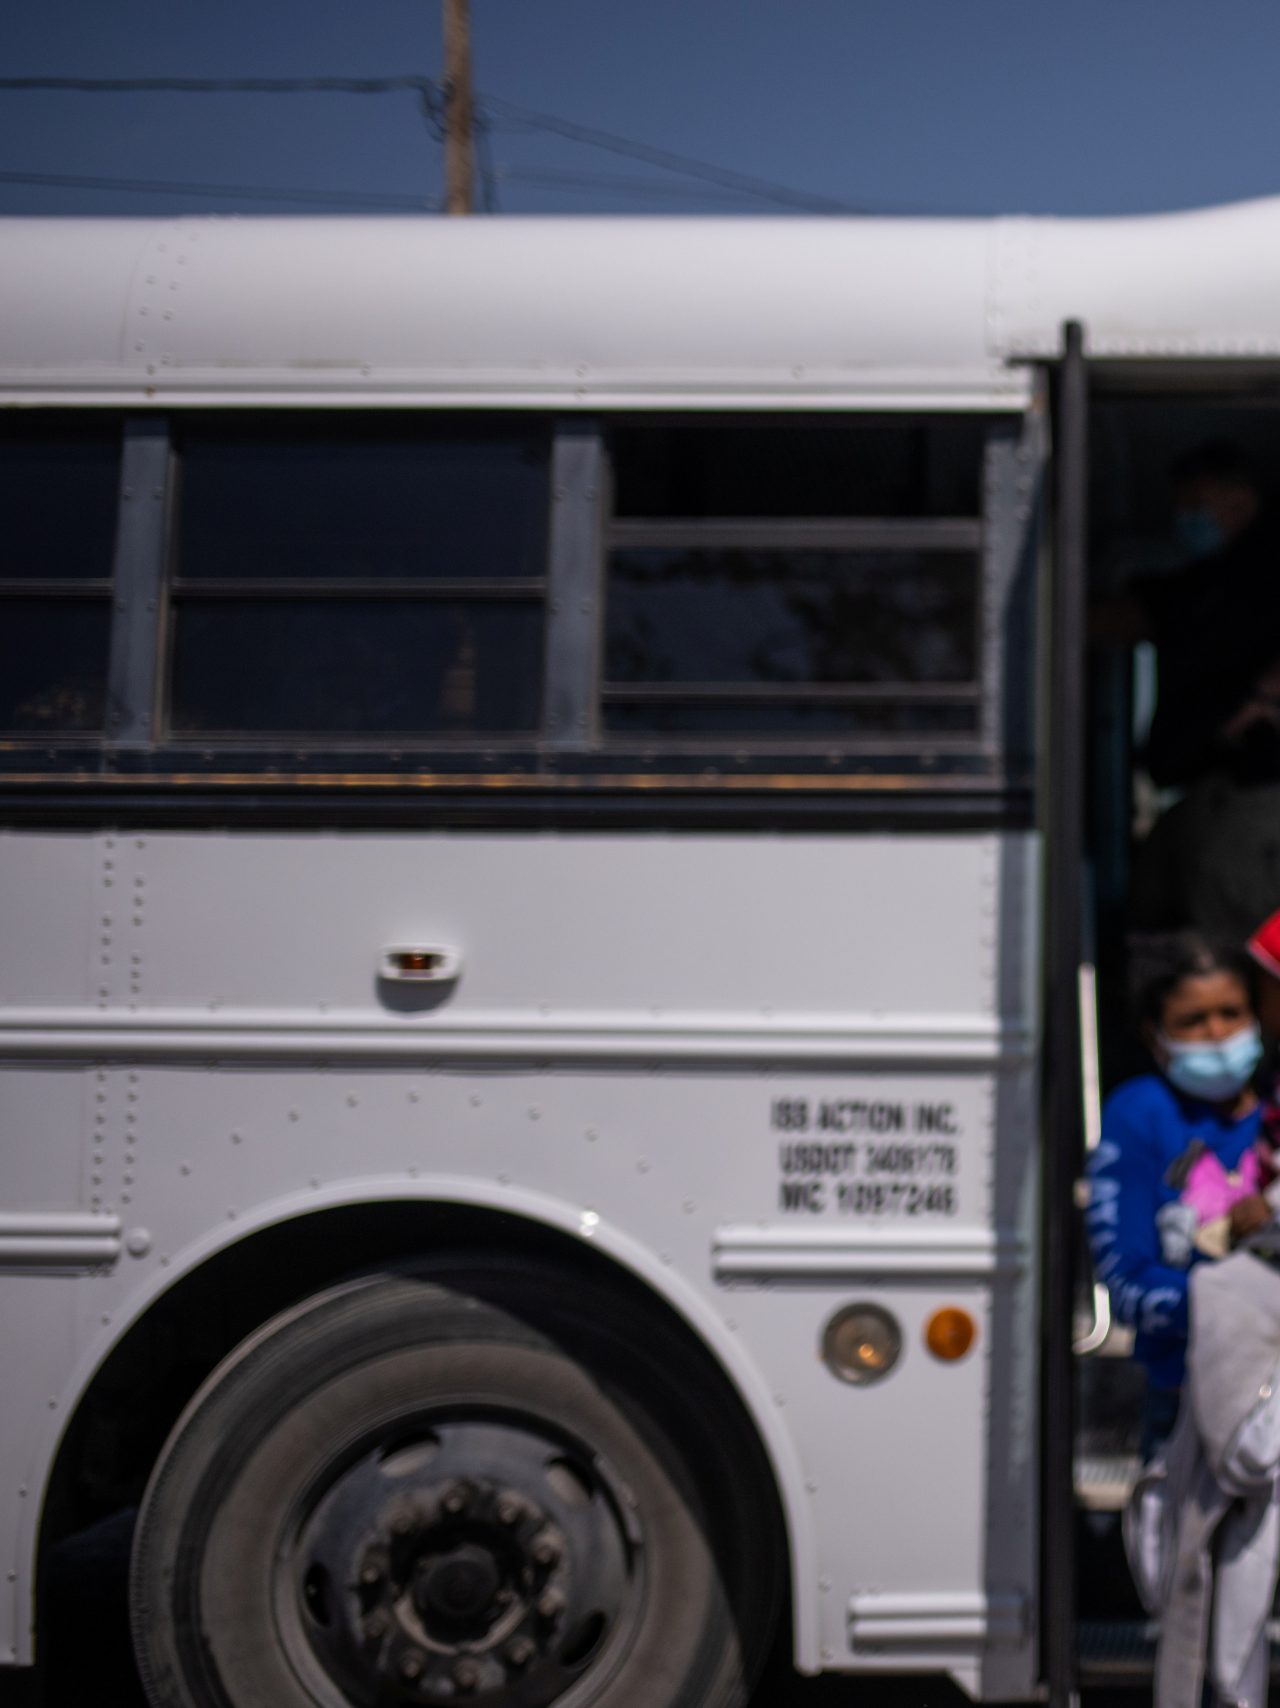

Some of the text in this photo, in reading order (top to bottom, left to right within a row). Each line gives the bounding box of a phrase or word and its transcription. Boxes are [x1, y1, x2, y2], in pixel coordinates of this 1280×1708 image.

[771, 1097, 809, 1131] ISS
[818, 1098, 904, 1133] ACTION
[780, 1142, 856, 1174] USDOT
[780, 1182, 825, 1214] MC
